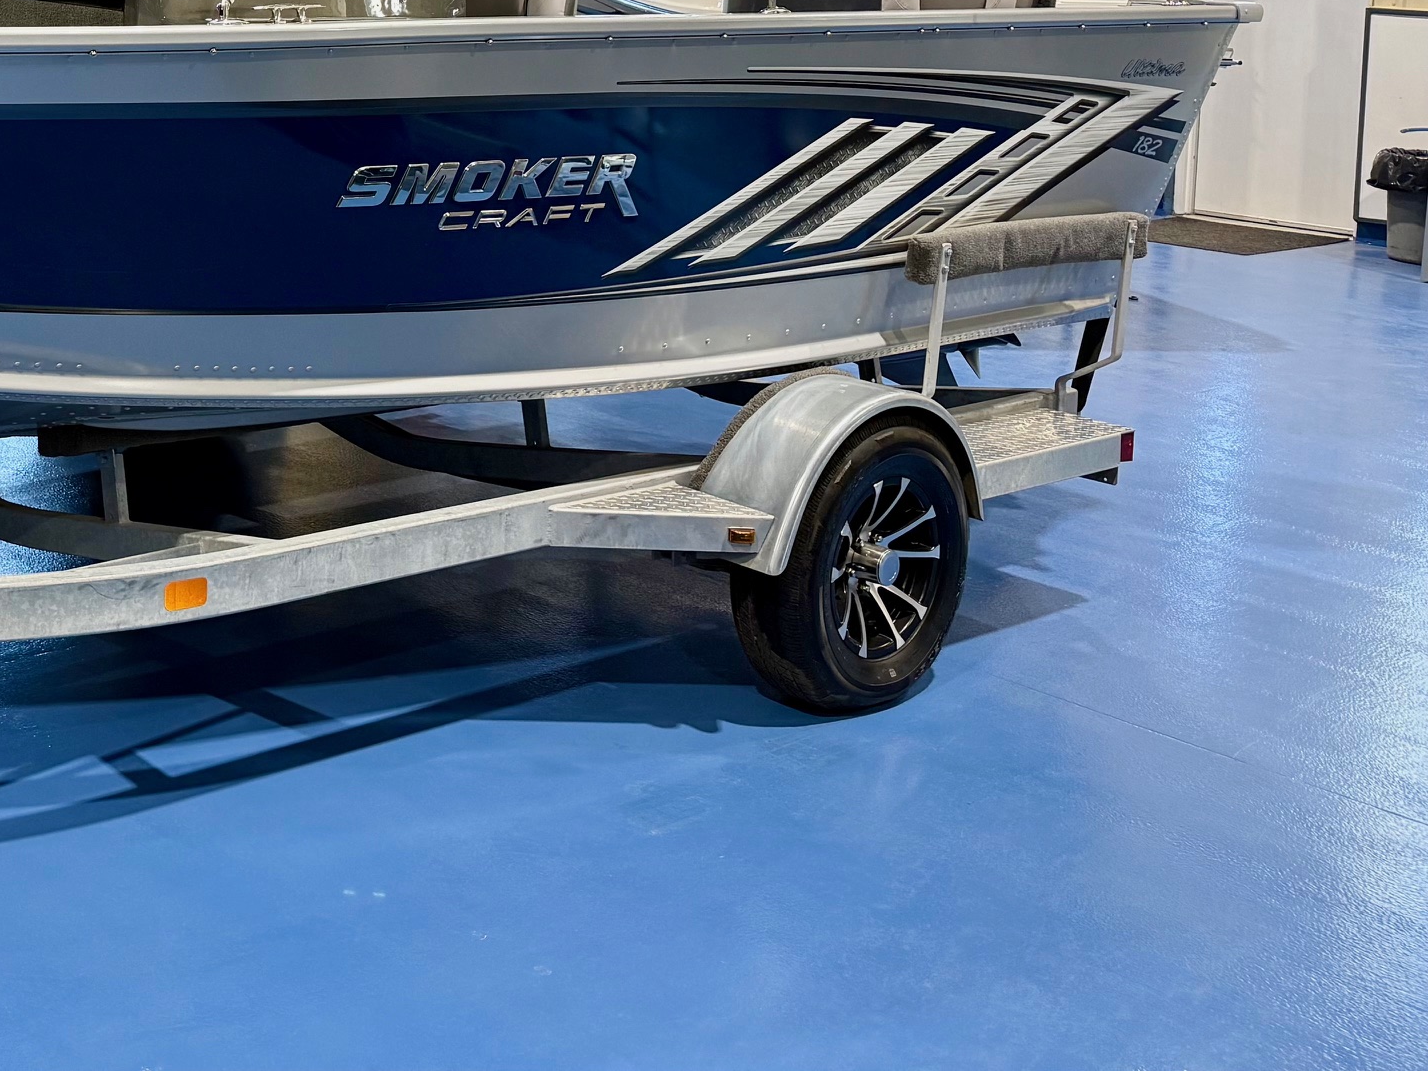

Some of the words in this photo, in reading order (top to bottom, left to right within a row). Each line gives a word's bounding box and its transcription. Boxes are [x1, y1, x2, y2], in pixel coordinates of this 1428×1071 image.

[1132, 135, 1163, 157] 182
[336, 152, 638, 217] SMOKER
[438, 203, 607, 232] CRAFT
